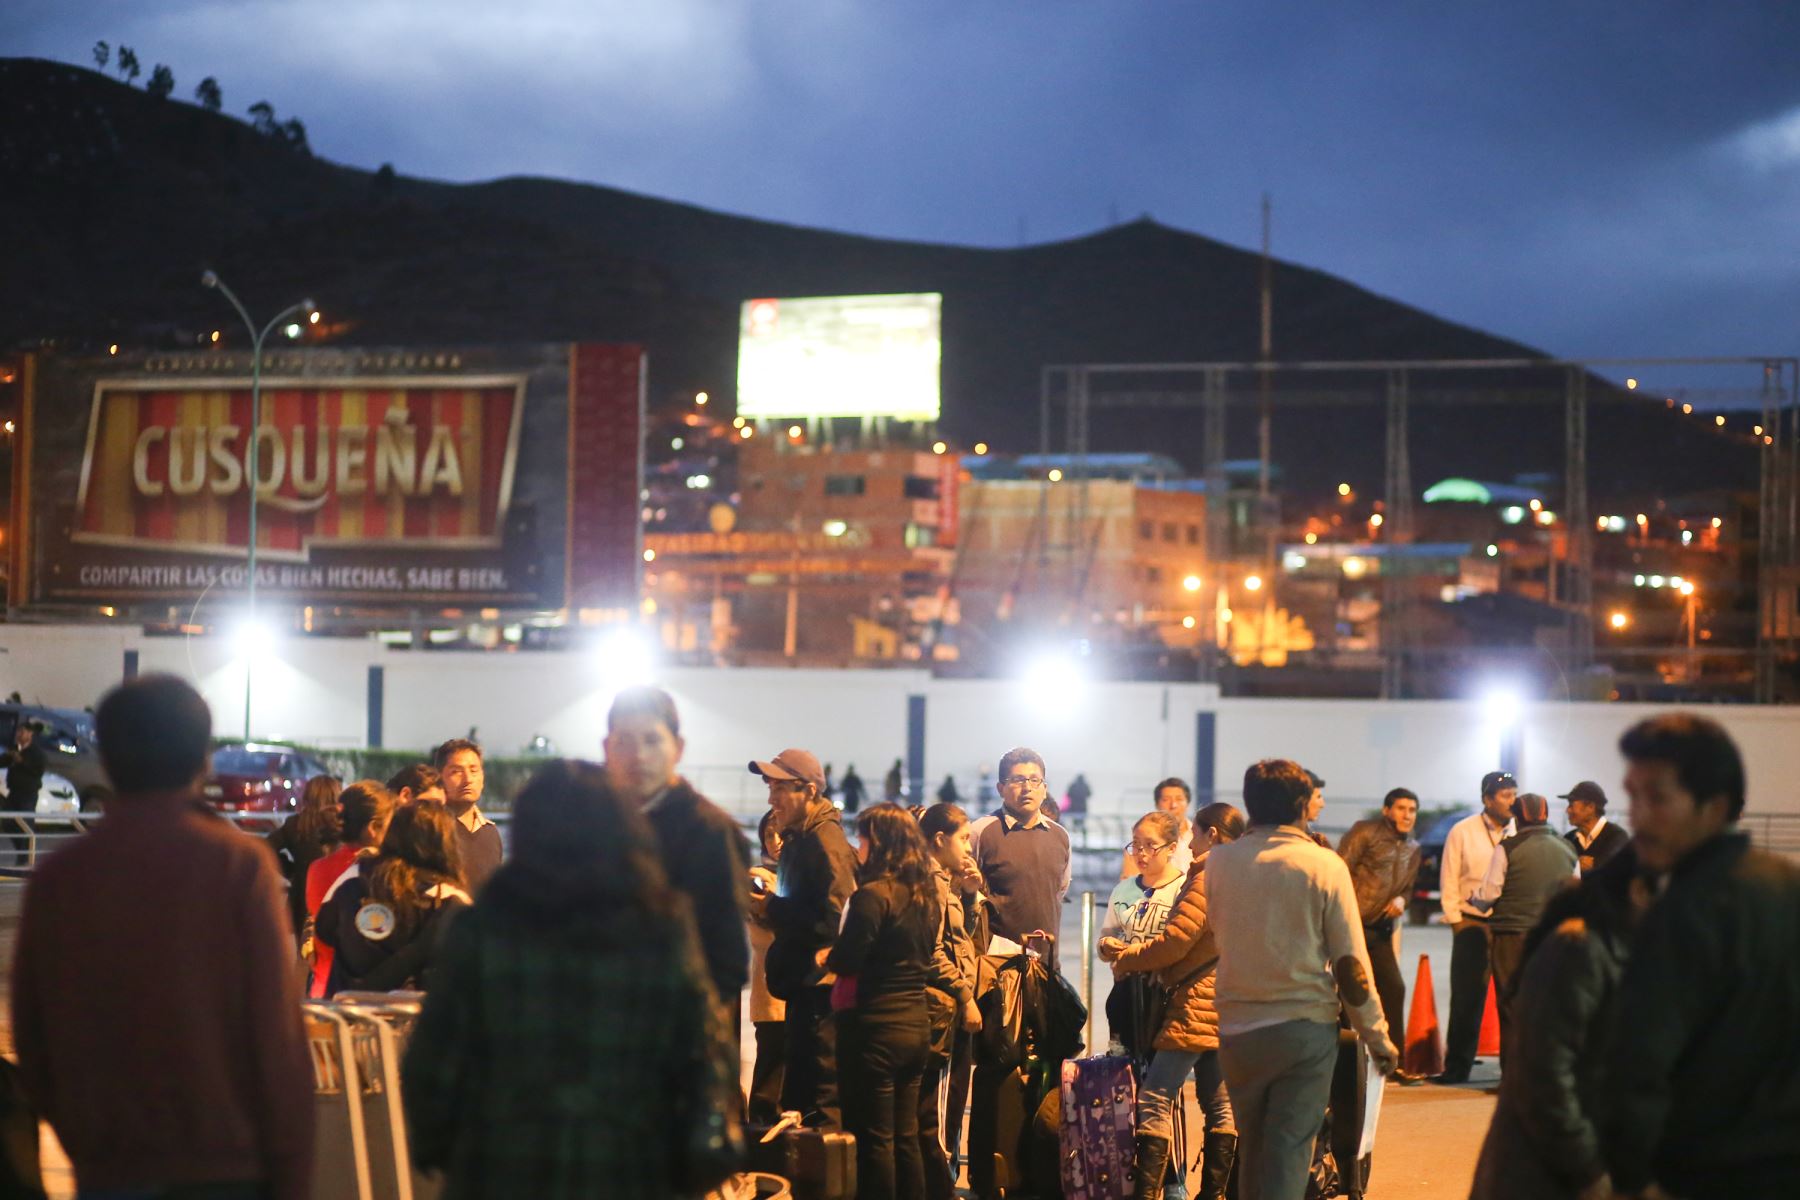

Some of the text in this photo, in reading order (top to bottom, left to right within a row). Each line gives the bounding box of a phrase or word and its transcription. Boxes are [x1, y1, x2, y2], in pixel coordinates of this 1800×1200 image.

[133, 405, 464, 513] CUSQUEÑA
[80, 565, 181, 586] COMPARTIR
[186, 566, 216, 586] LAS
[407, 567, 455, 590] SABE
